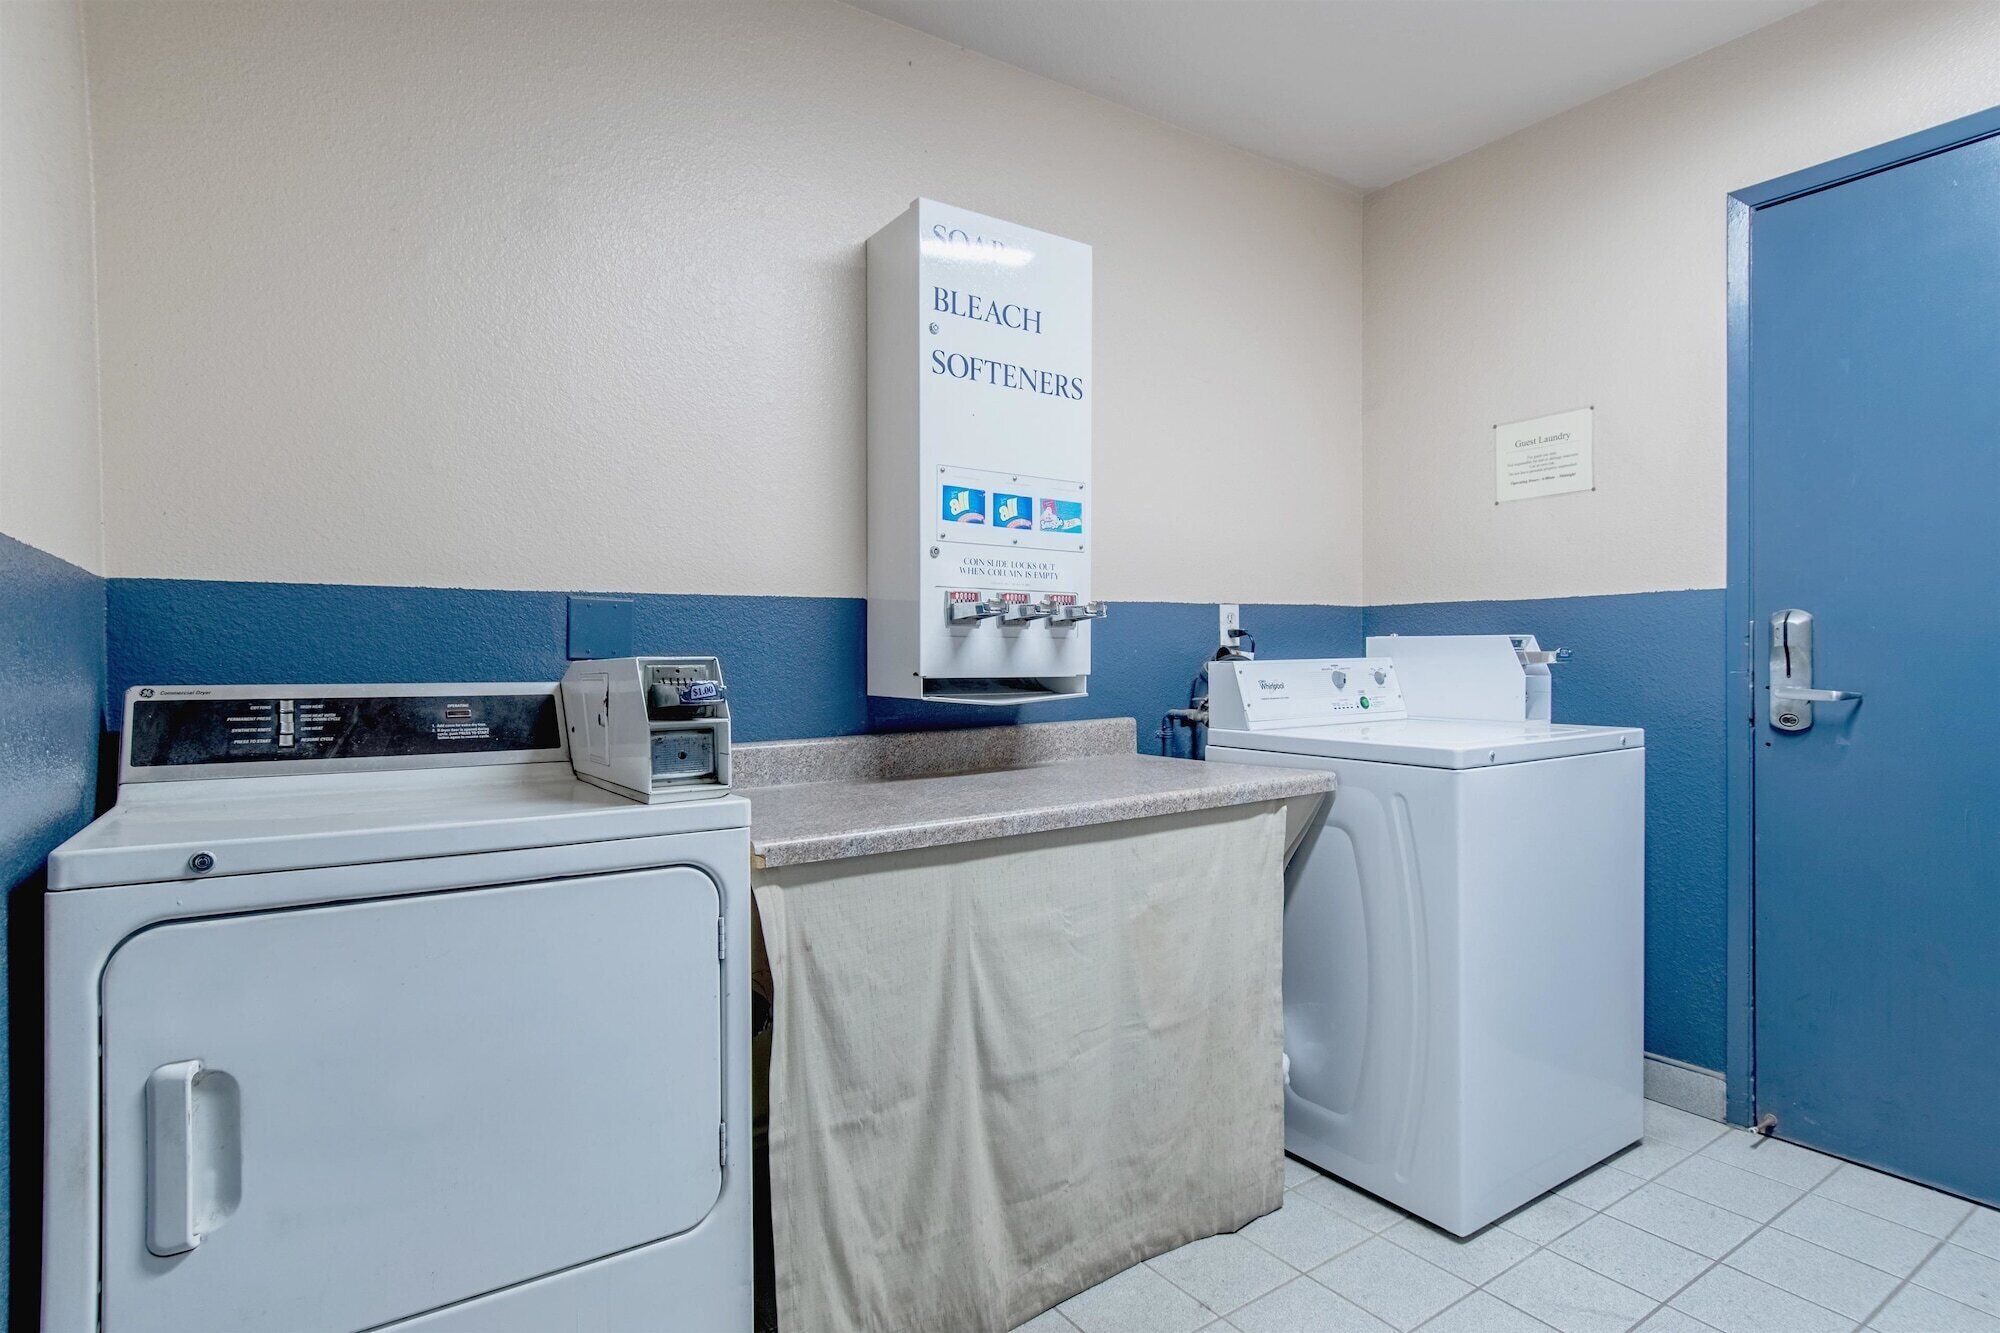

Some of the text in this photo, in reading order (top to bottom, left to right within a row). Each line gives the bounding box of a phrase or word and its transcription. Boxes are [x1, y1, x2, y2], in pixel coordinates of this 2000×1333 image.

[933, 286, 1042, 334] BLEACH
[932, 349, 1083, 401] SOFTENERS
[1514, 432, 1571, 448] Guest Laundry
[963, 557, 1056, 571] COIN SLIDE LOCKS OUT
[960, 567, 1059, 580] WHEN COLUMN IS EMPTY
[693, 686, 714, 697] $1.00
[1258, 680, 1285, 690] Whirlpool
